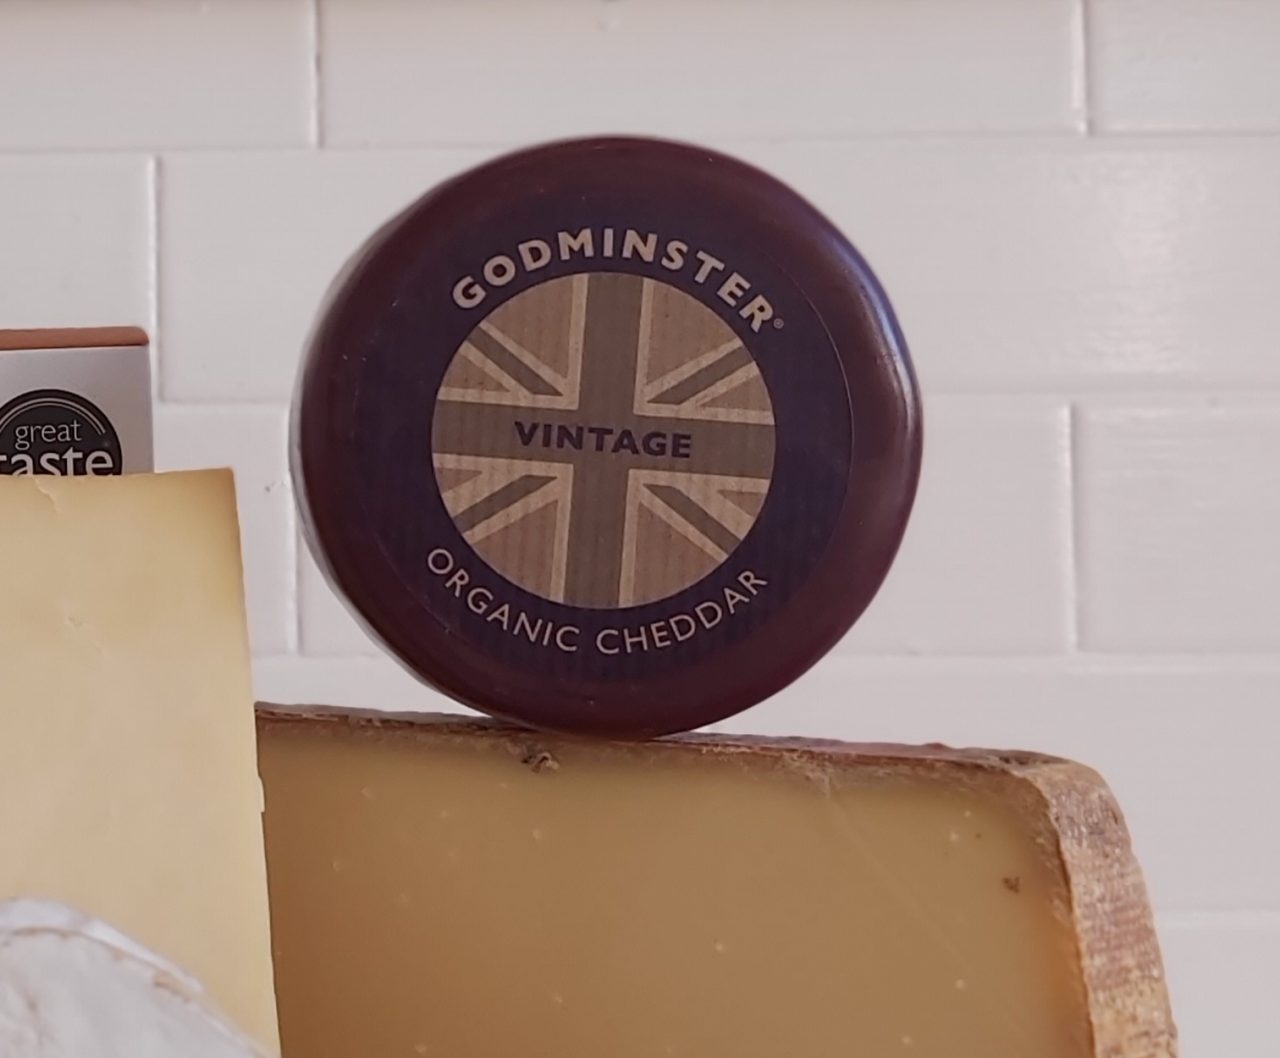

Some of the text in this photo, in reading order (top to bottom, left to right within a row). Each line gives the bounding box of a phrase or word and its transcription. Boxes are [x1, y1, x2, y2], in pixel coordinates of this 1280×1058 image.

[14, 418, 83, 451] great
[514, 421, 692, 459] VINTAGE
[425, 548, 768, 655] ORGANIC CHEDDAR
